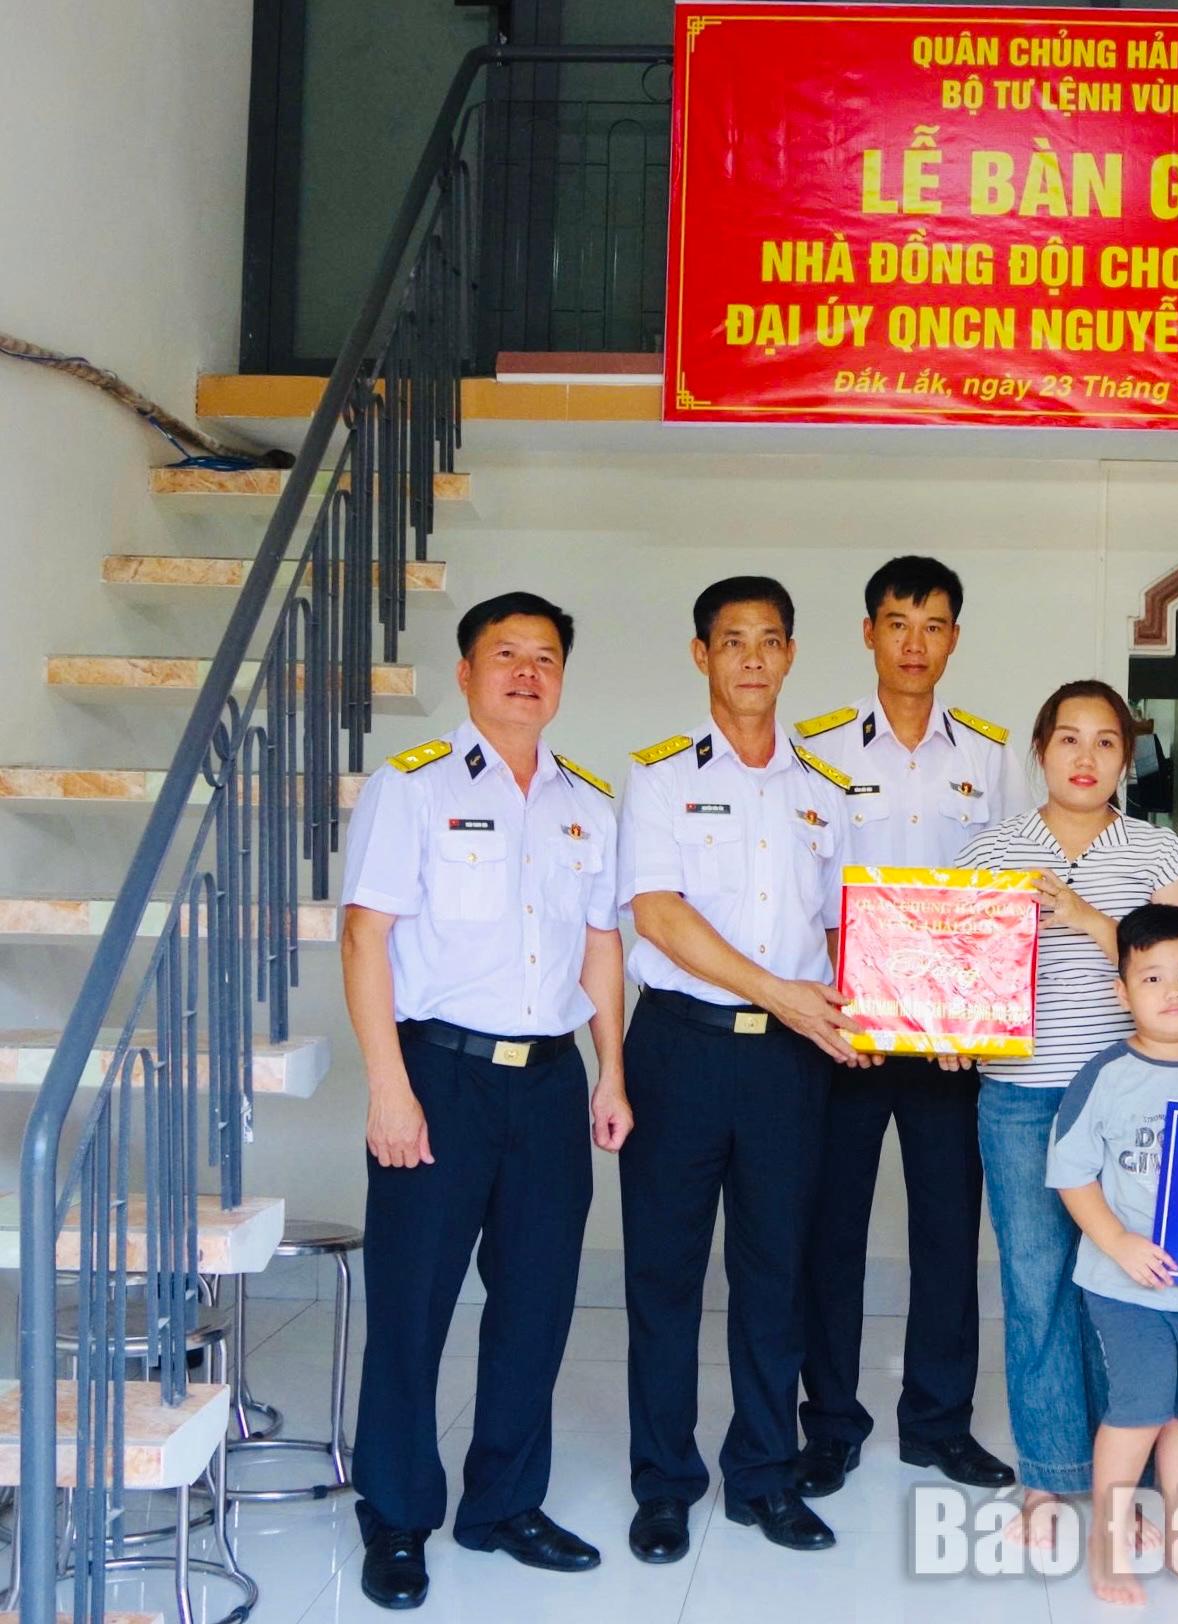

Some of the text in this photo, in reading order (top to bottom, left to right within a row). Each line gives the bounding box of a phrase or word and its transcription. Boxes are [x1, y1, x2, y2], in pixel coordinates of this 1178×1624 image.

[914, 32, 998, 67] QUÂN
[1010, 30, 1116, 67] CHỦNG
[1128, 32, 1178, 68] HẢI
[943, 80, 983, 115] BỘ
[994, 79, 1034, 110] TƯ
[1042, 79, 1121, 116] LỆNH
[862, 125, 941, 214] LỄ
[970, 138, 1122, 217] BÀN
[763, 233, 854, 282] NHÀ
[869, 228, 993, 285] ĐỒNG
[1008, 236, 1083, 295] ĐỘI
[726, 307, 800, 357] ĐẠI
[816, 297, 873, 347] ÚY
[889, 306, 1015, 352] QNCN
[833, 369, 886, 393] Đắk
[896, 369, 951, 396] Lắk,
[964, 376, 1031, 400] ngày
[1040, 375, 1073, 397] 23
[1084, 375, 1169, 402] Tháng
